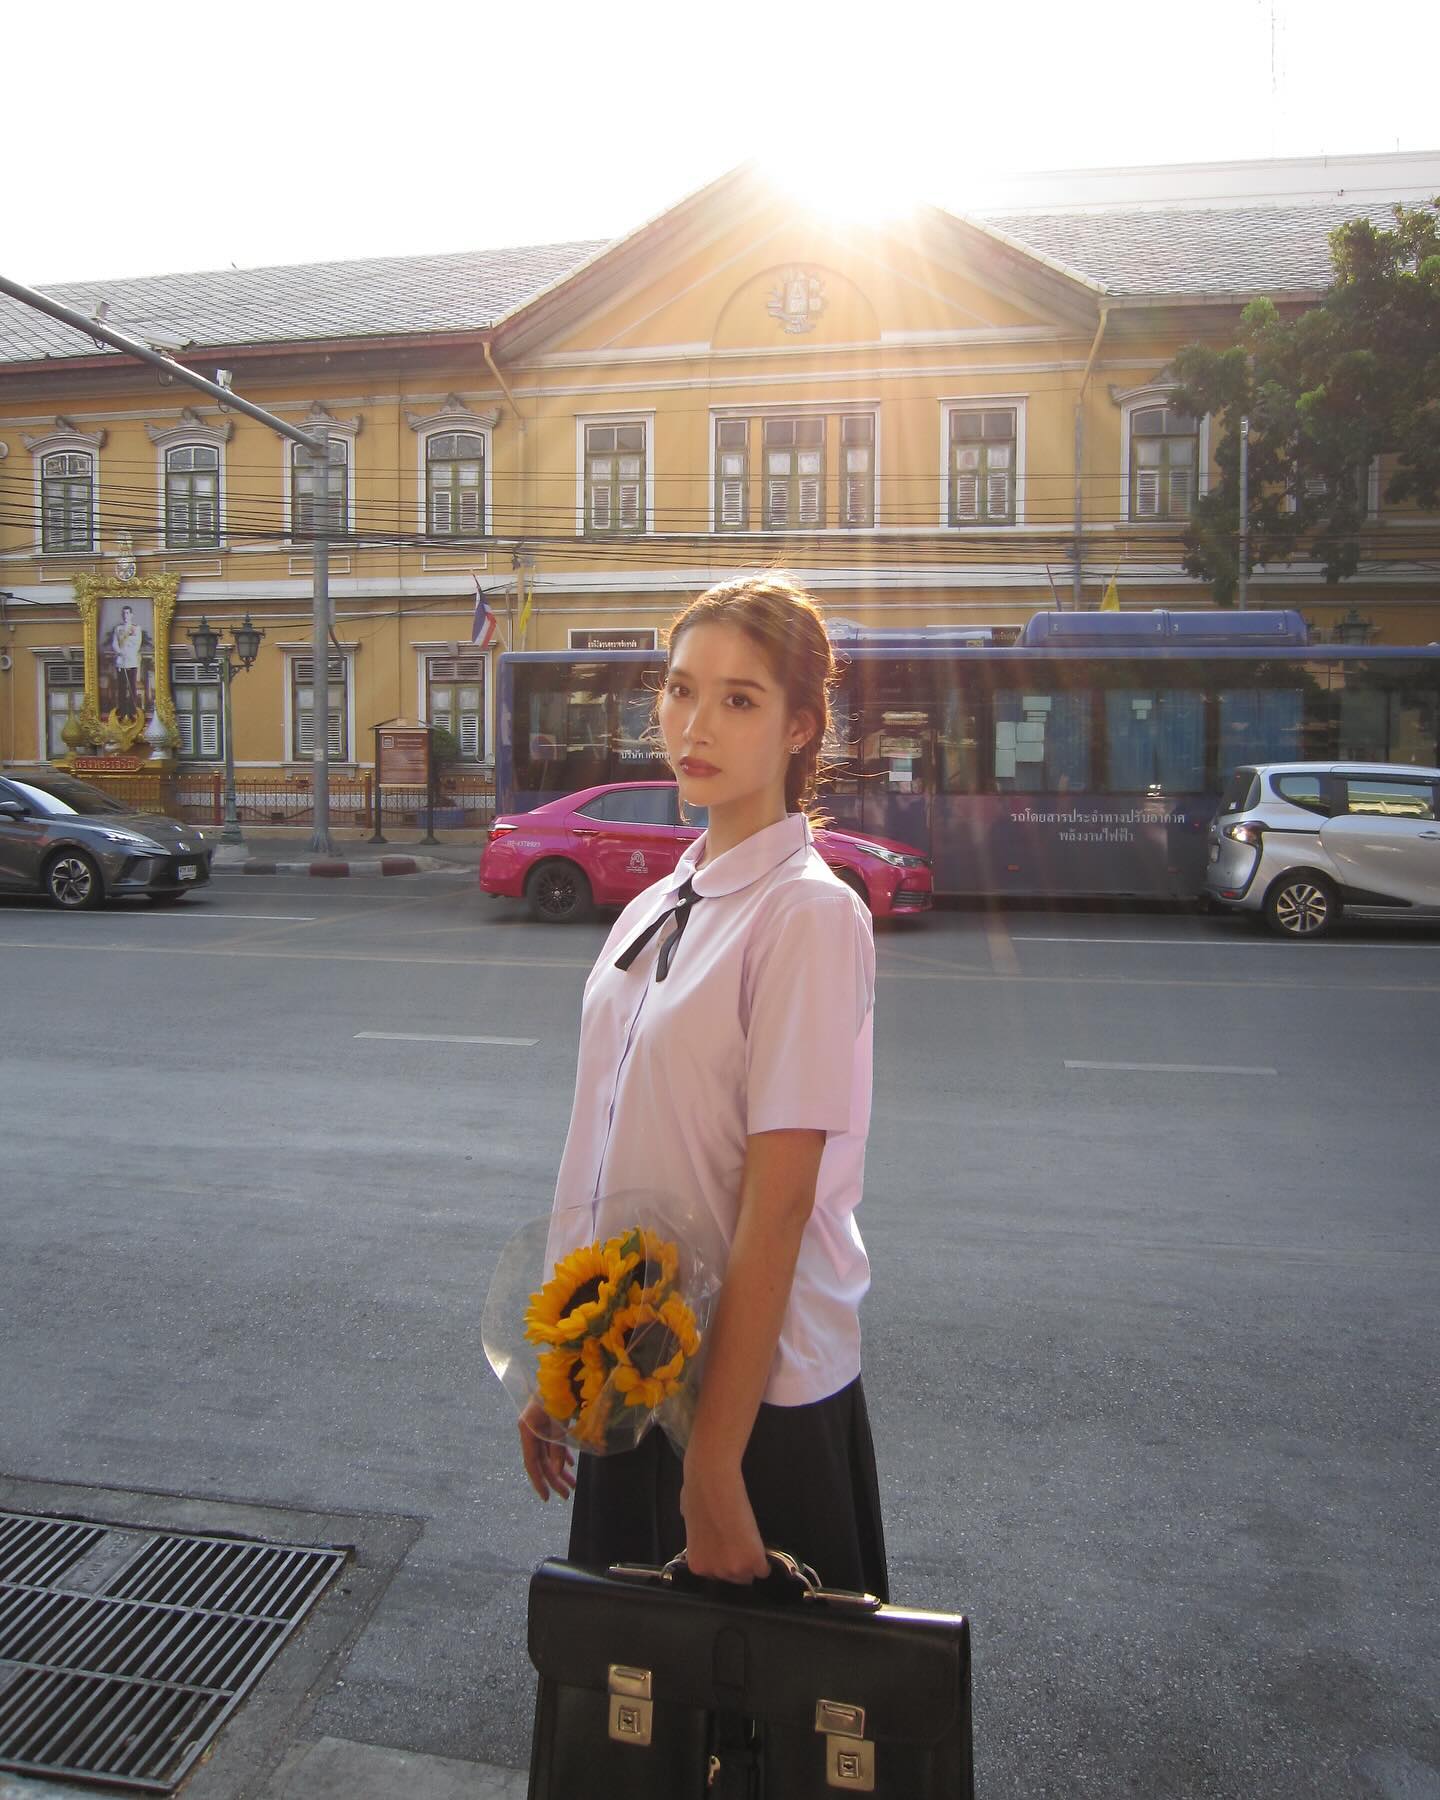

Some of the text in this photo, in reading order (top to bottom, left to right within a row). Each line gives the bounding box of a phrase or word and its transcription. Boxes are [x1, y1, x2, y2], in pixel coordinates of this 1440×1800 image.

[1010, 807, 1185, 824] รถโดยสารประจำทางปรับอากาศ
[1059, 827, 1135, 843] พลังงานไฟฟ้า
